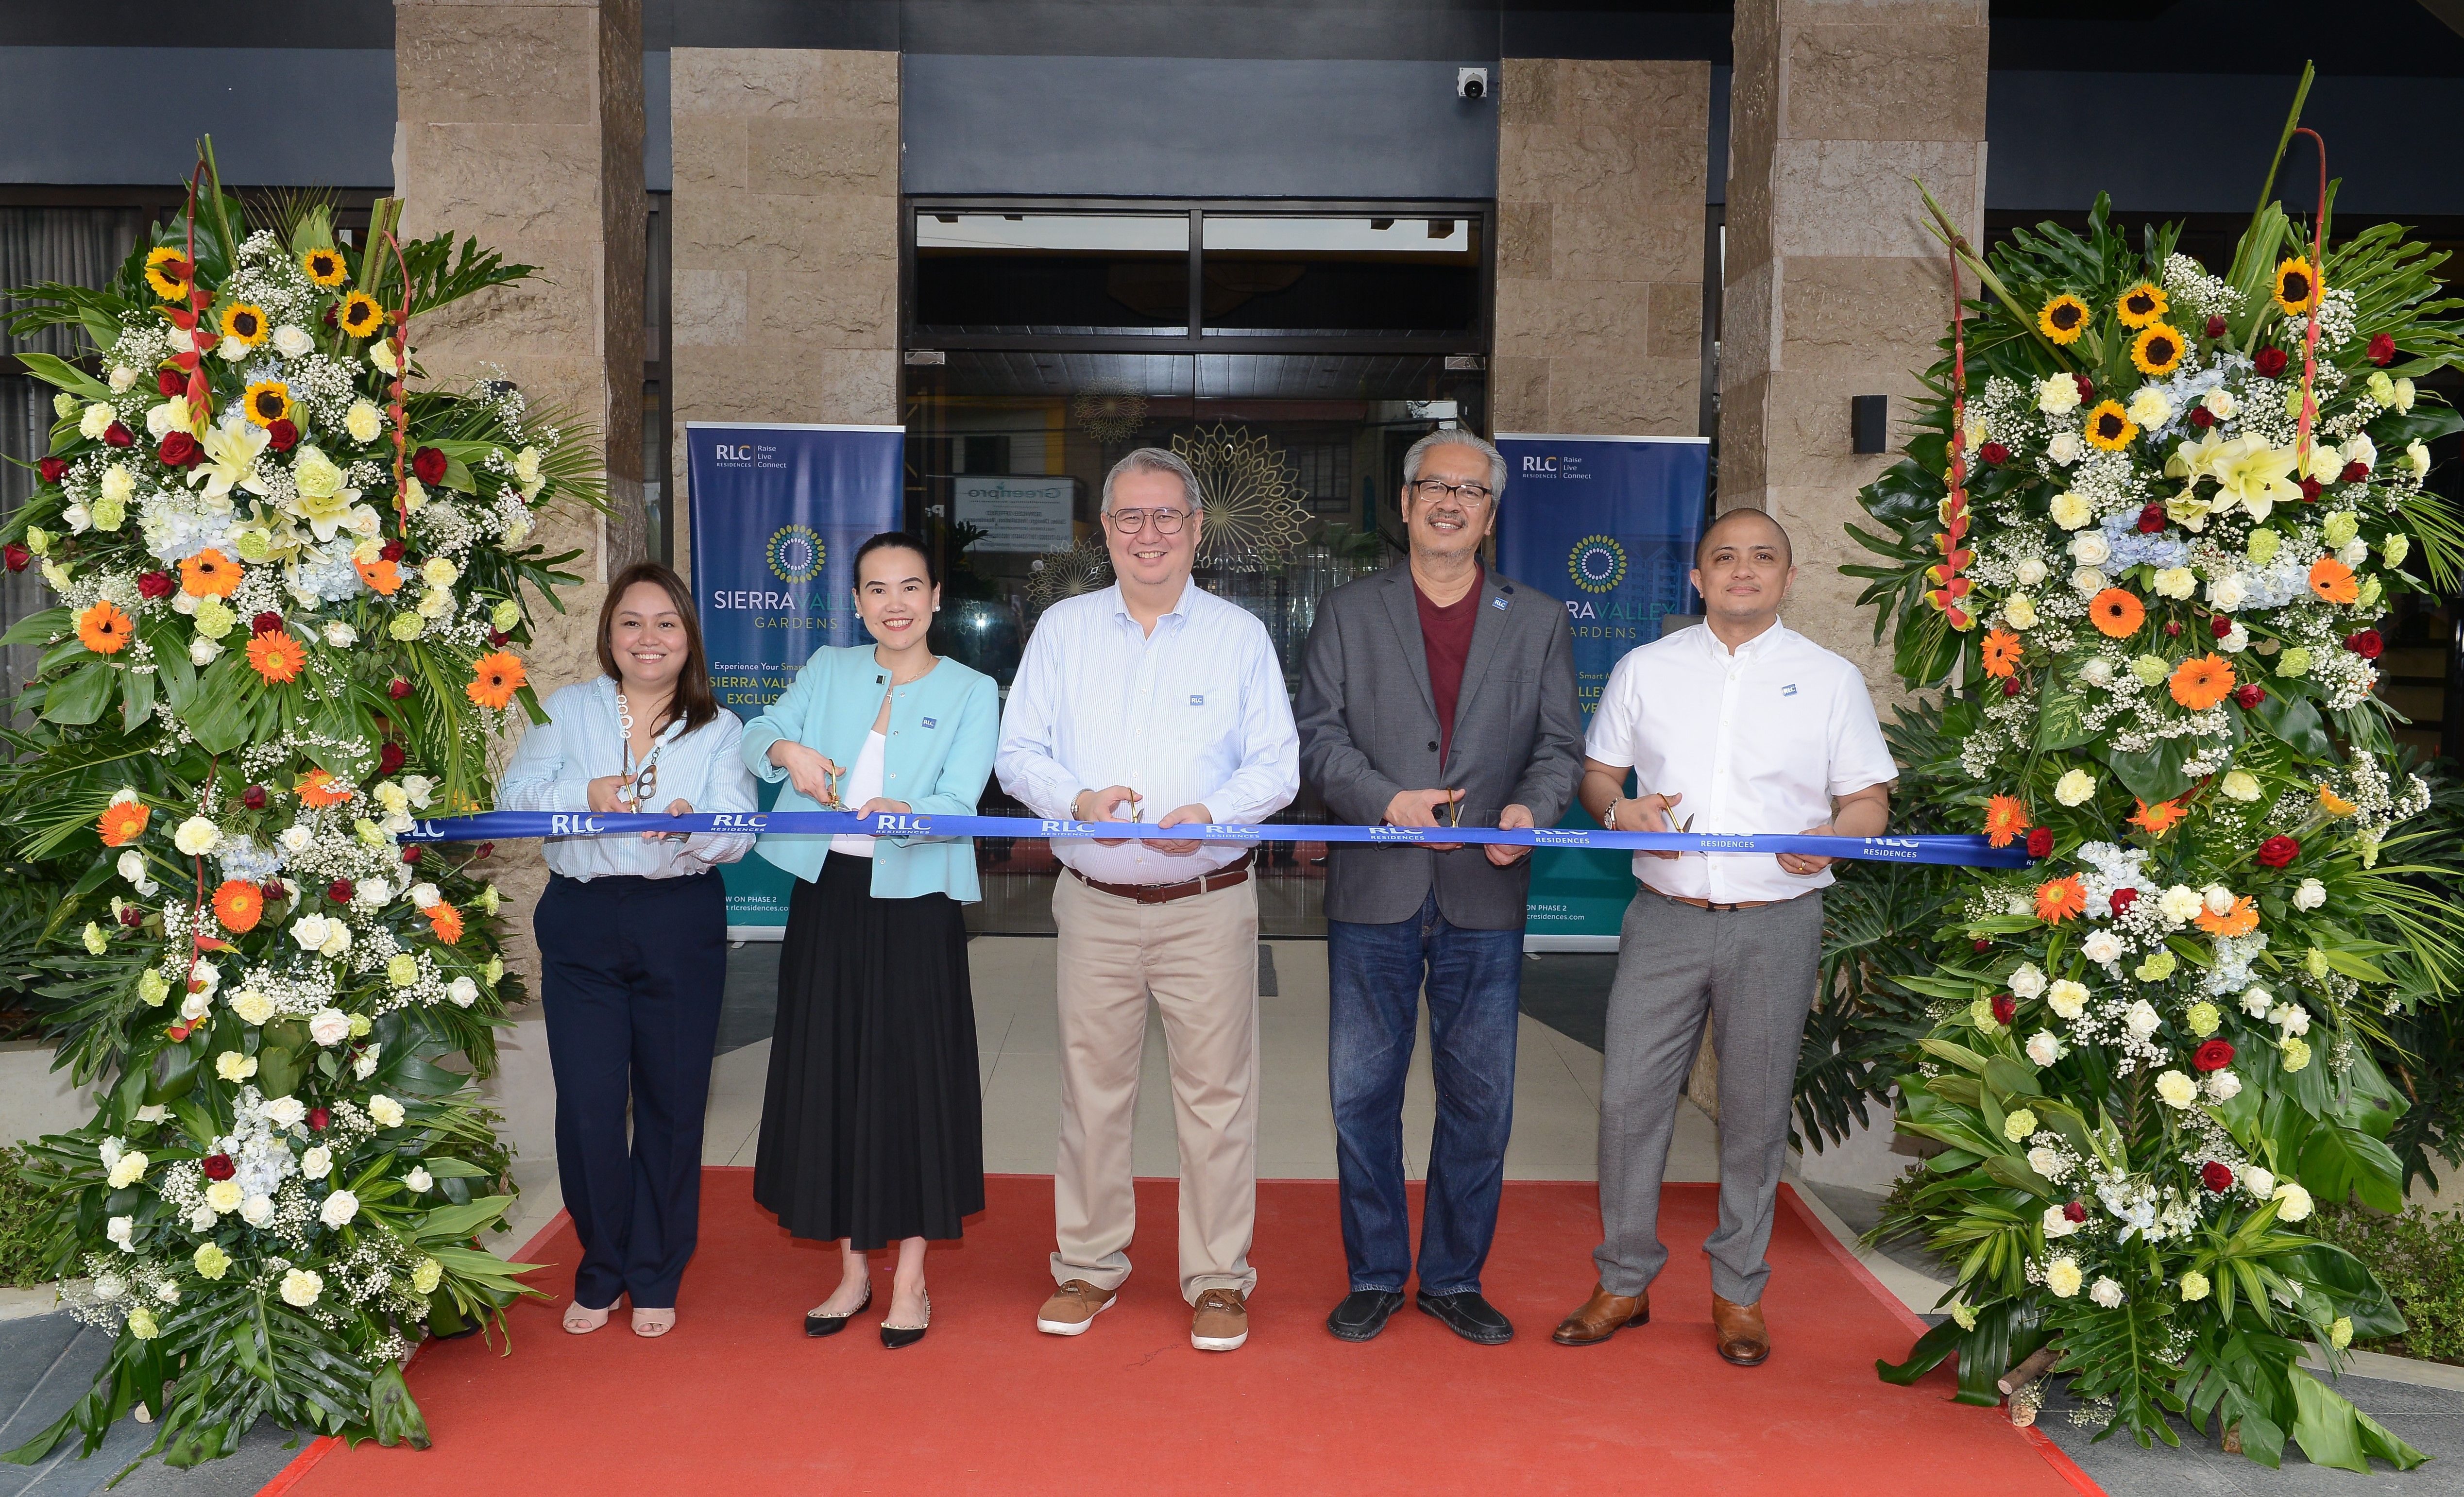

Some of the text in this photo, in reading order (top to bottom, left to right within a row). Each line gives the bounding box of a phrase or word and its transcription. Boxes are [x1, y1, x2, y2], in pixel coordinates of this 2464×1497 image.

[716, 445, 751, 460] RLC
[1523, 456, 1557, 471] RLC
[1495, 599, 1506, 607] RLC
[754, 617, 837, 629] GARDENS
[714, 661, 759, 672] Experience
[709, 676, 758, 688] SIERRA
[552, 814, 605, 834] RLC
[713, 814, 767, 826] RLC
[877, 815, 932, 830] RLC
[1042, 821, 1095, 832] RLC
[1864, 848, 1917, 858] RESIDENCES
